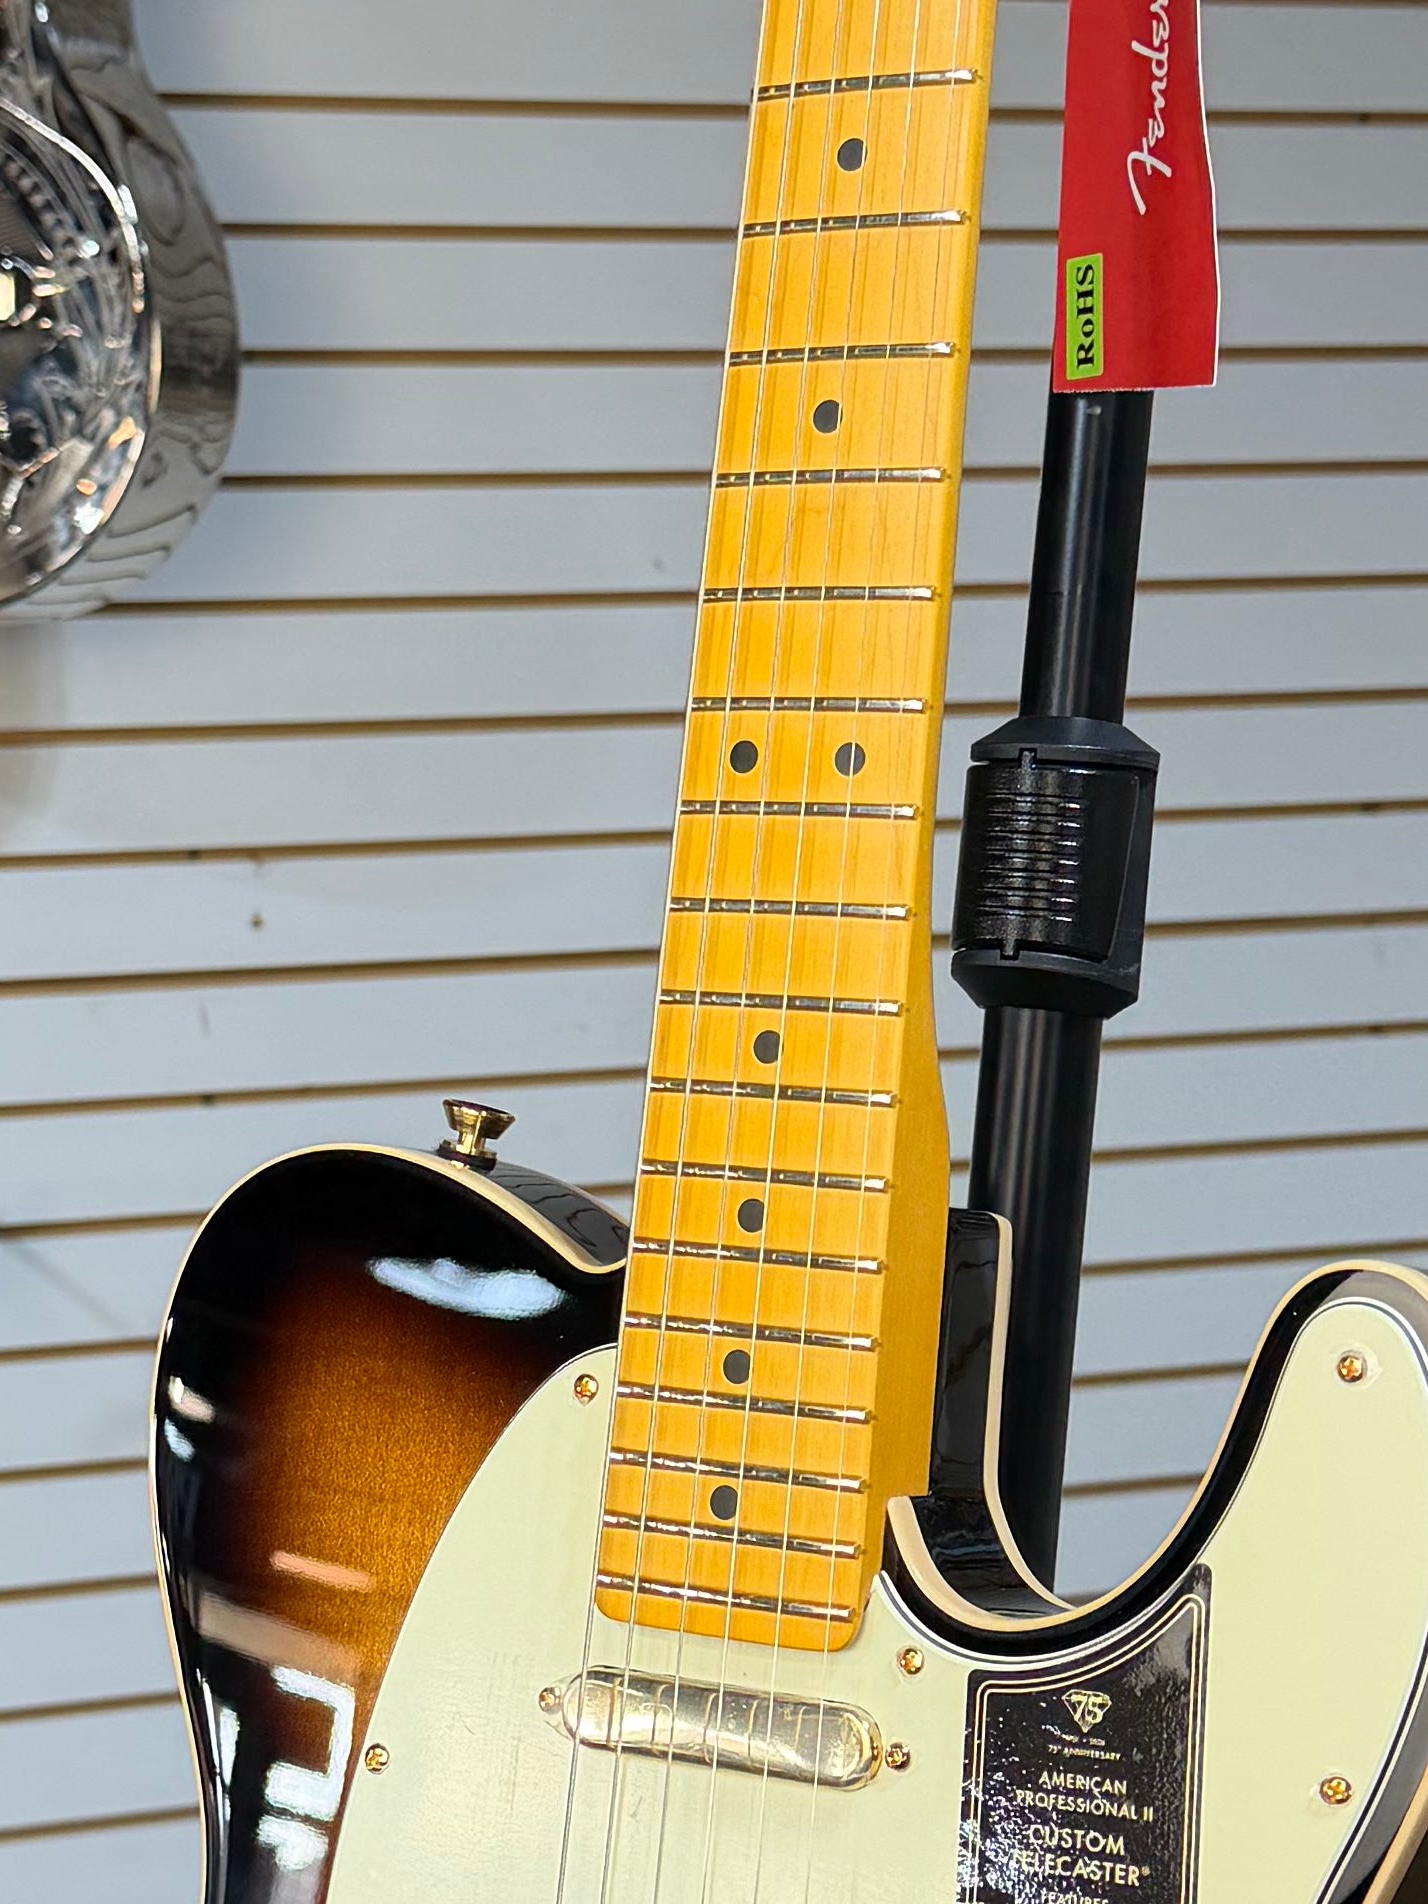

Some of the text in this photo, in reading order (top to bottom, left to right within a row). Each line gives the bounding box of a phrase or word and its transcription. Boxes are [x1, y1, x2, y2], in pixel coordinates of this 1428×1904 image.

[1076, 264, 1098, 370] RoHS
[1071, 1695, 1103, 1724] 75
[1038, 1771, 1127, 1796] AMERICAN
[1015, 1789, 1153, 1823] PROFESSIONAL II
[1029, 1824, 1125, 1856] CUSTOM
